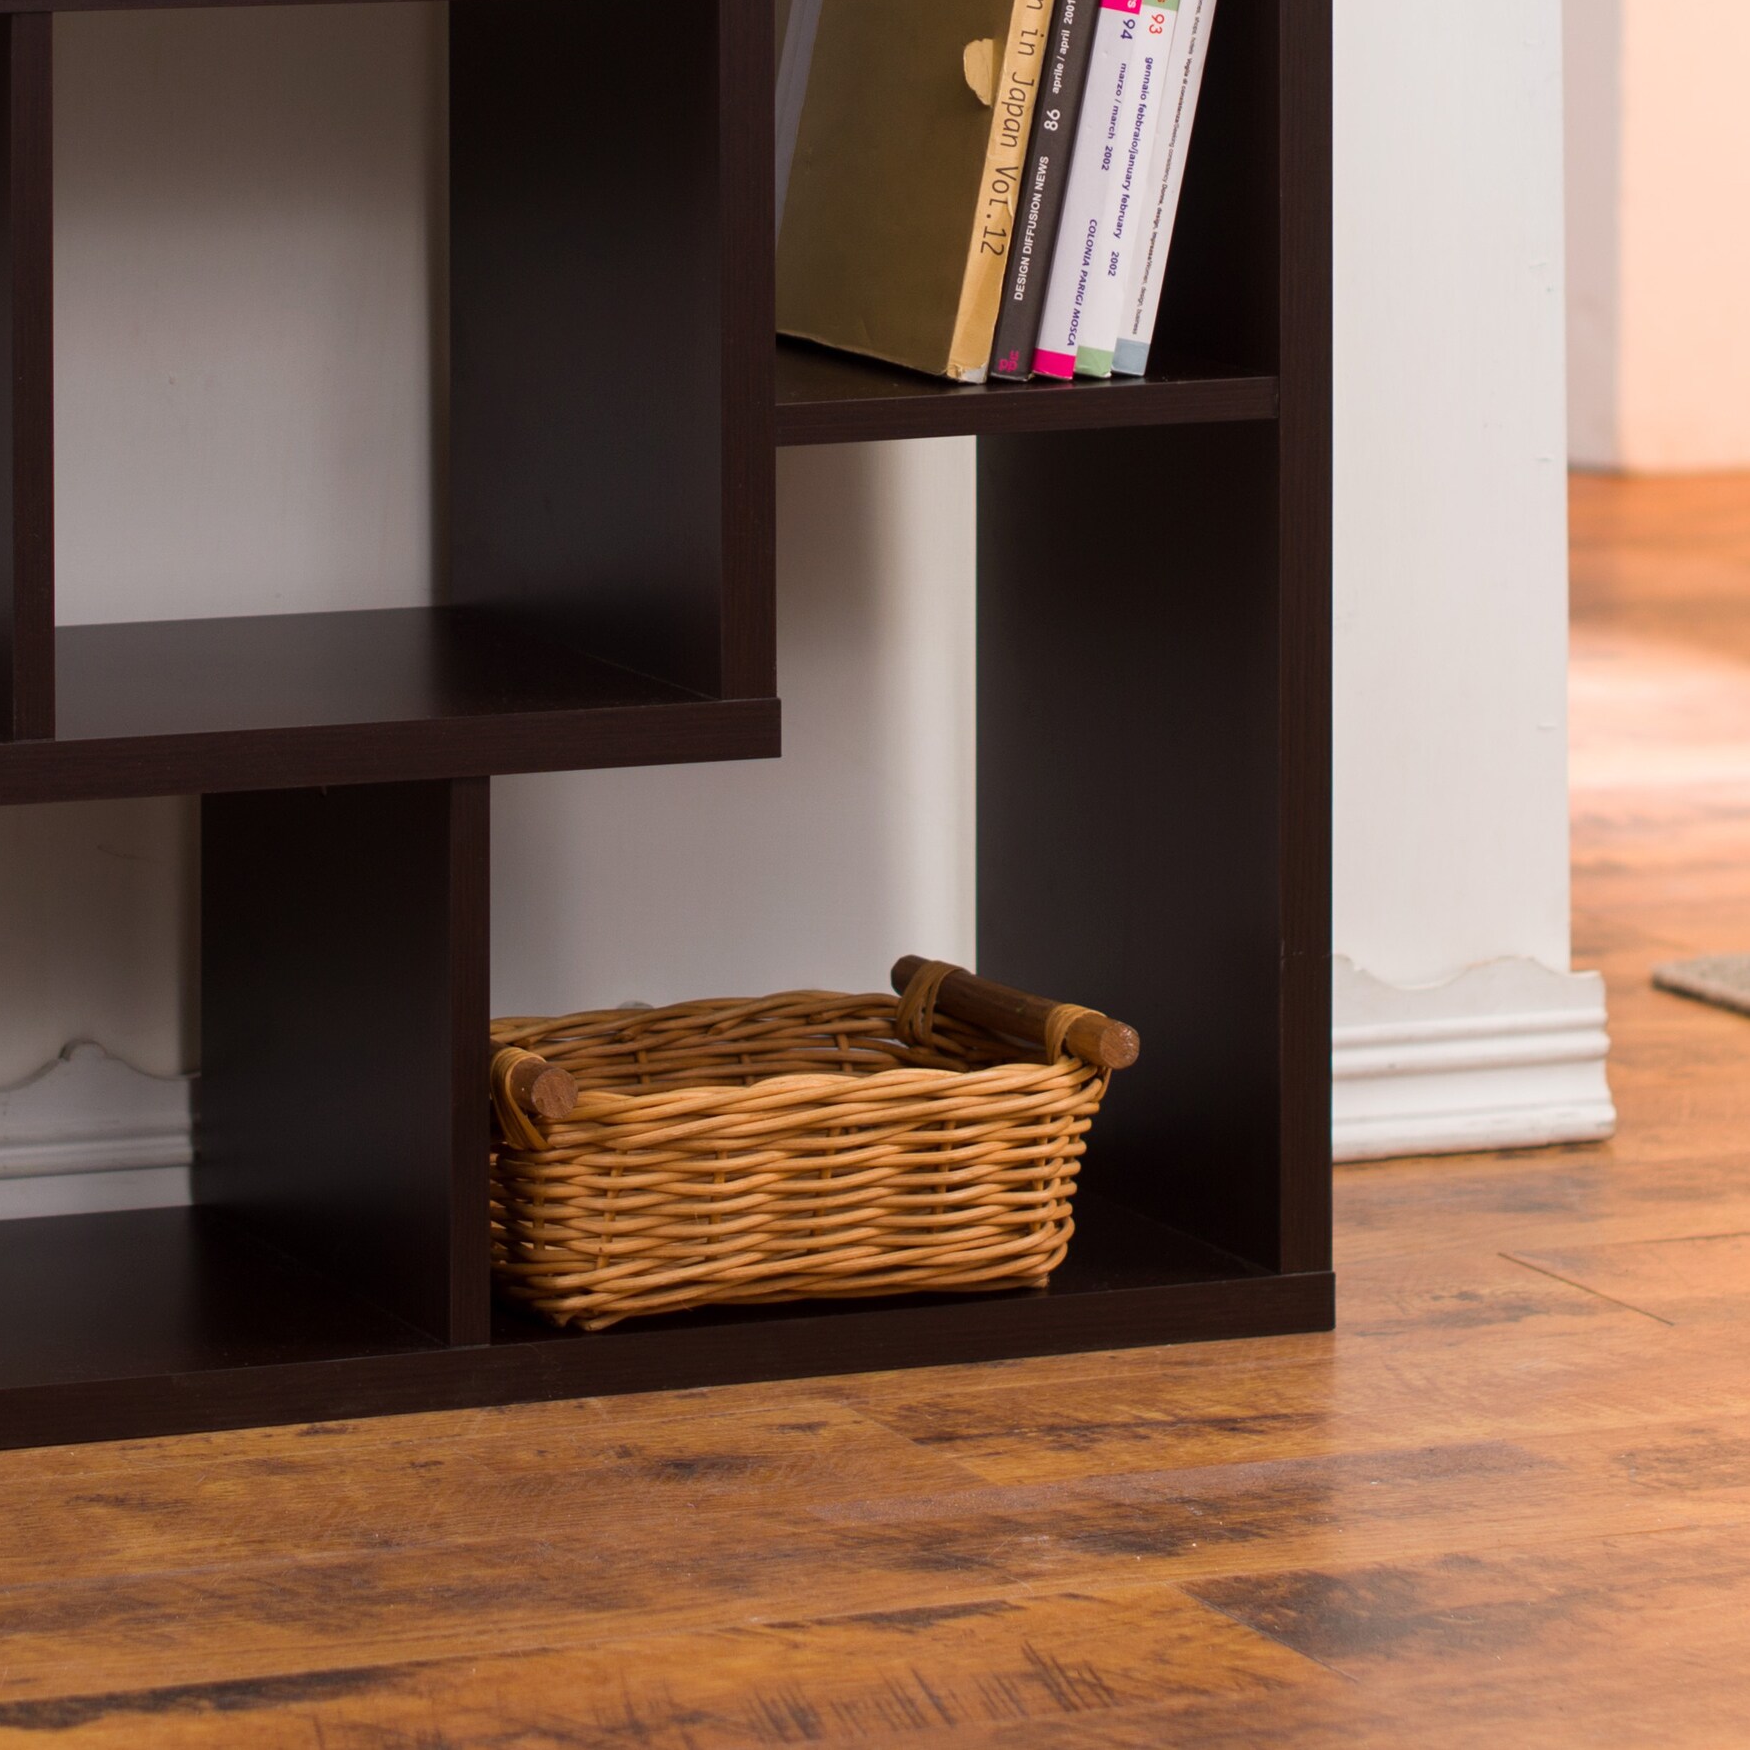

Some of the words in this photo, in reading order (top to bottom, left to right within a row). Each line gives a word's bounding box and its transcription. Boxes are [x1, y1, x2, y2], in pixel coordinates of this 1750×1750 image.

[1063, 0, 1076, 25] 2001
[1120, 18, 1136, 40] 94
[1149, 13, 1165, 35] 93
[1018, 28, 1045, 56] in
[1060, 29, 1071, 55] april
[1052, 65, 1065, 95] aprile
[1115, 62, 1127, 96] marzo
[1140, 57, 1154, 101] gennaio
[1000, 71, 1034, 148] Japan
[1043, 108, 1061, 131] 86
[1107, 105, 1119, 140] march
[1034, 155, 1050, 191] NEWS
[1101, 145, 1113, 171] 2002
[1022, 192, 1042, 255] DIFFUSION
[1113, 193, 1130, 239] february
[1082, 218, 1097, 266] COLONIA
[1014, 256, 1031, 301] DESIGN
[1107, 251, 1119, 277] 2002
[1074, 269, 1088, 306] PARIGI
[1067, 307, 1082, 346] MOSCA
